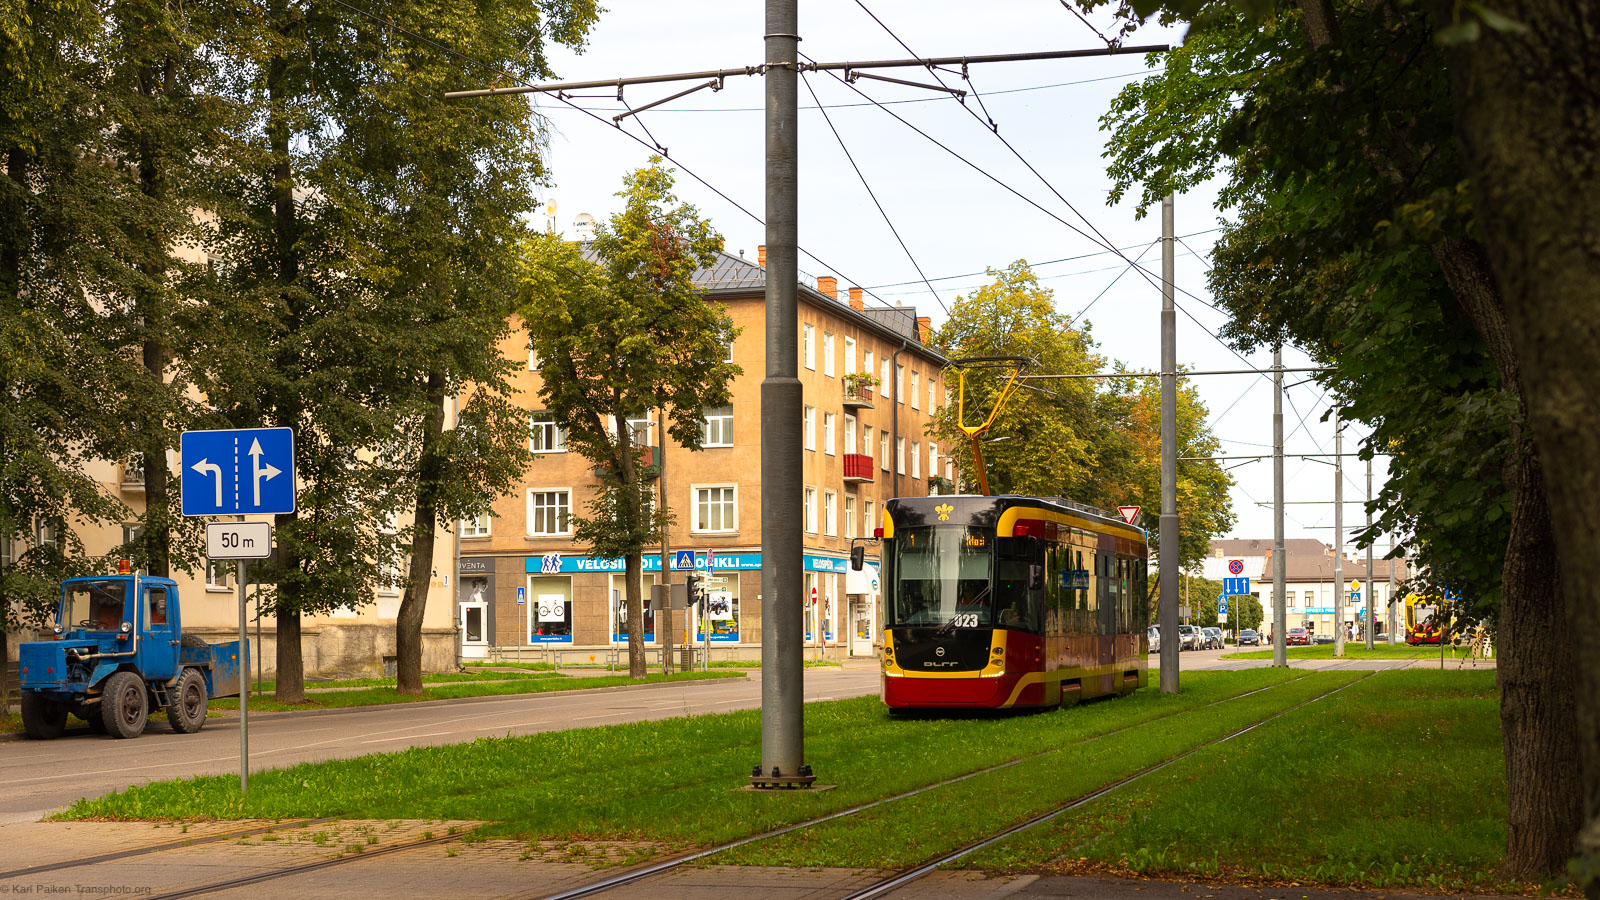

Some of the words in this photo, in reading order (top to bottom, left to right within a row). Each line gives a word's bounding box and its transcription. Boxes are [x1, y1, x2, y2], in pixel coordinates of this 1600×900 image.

[222, 532, 239, 548] 50
[243, 538, 254, 548] m
[1219, 605, 1226, 613] P
[954, 613, 979, 628] 023
